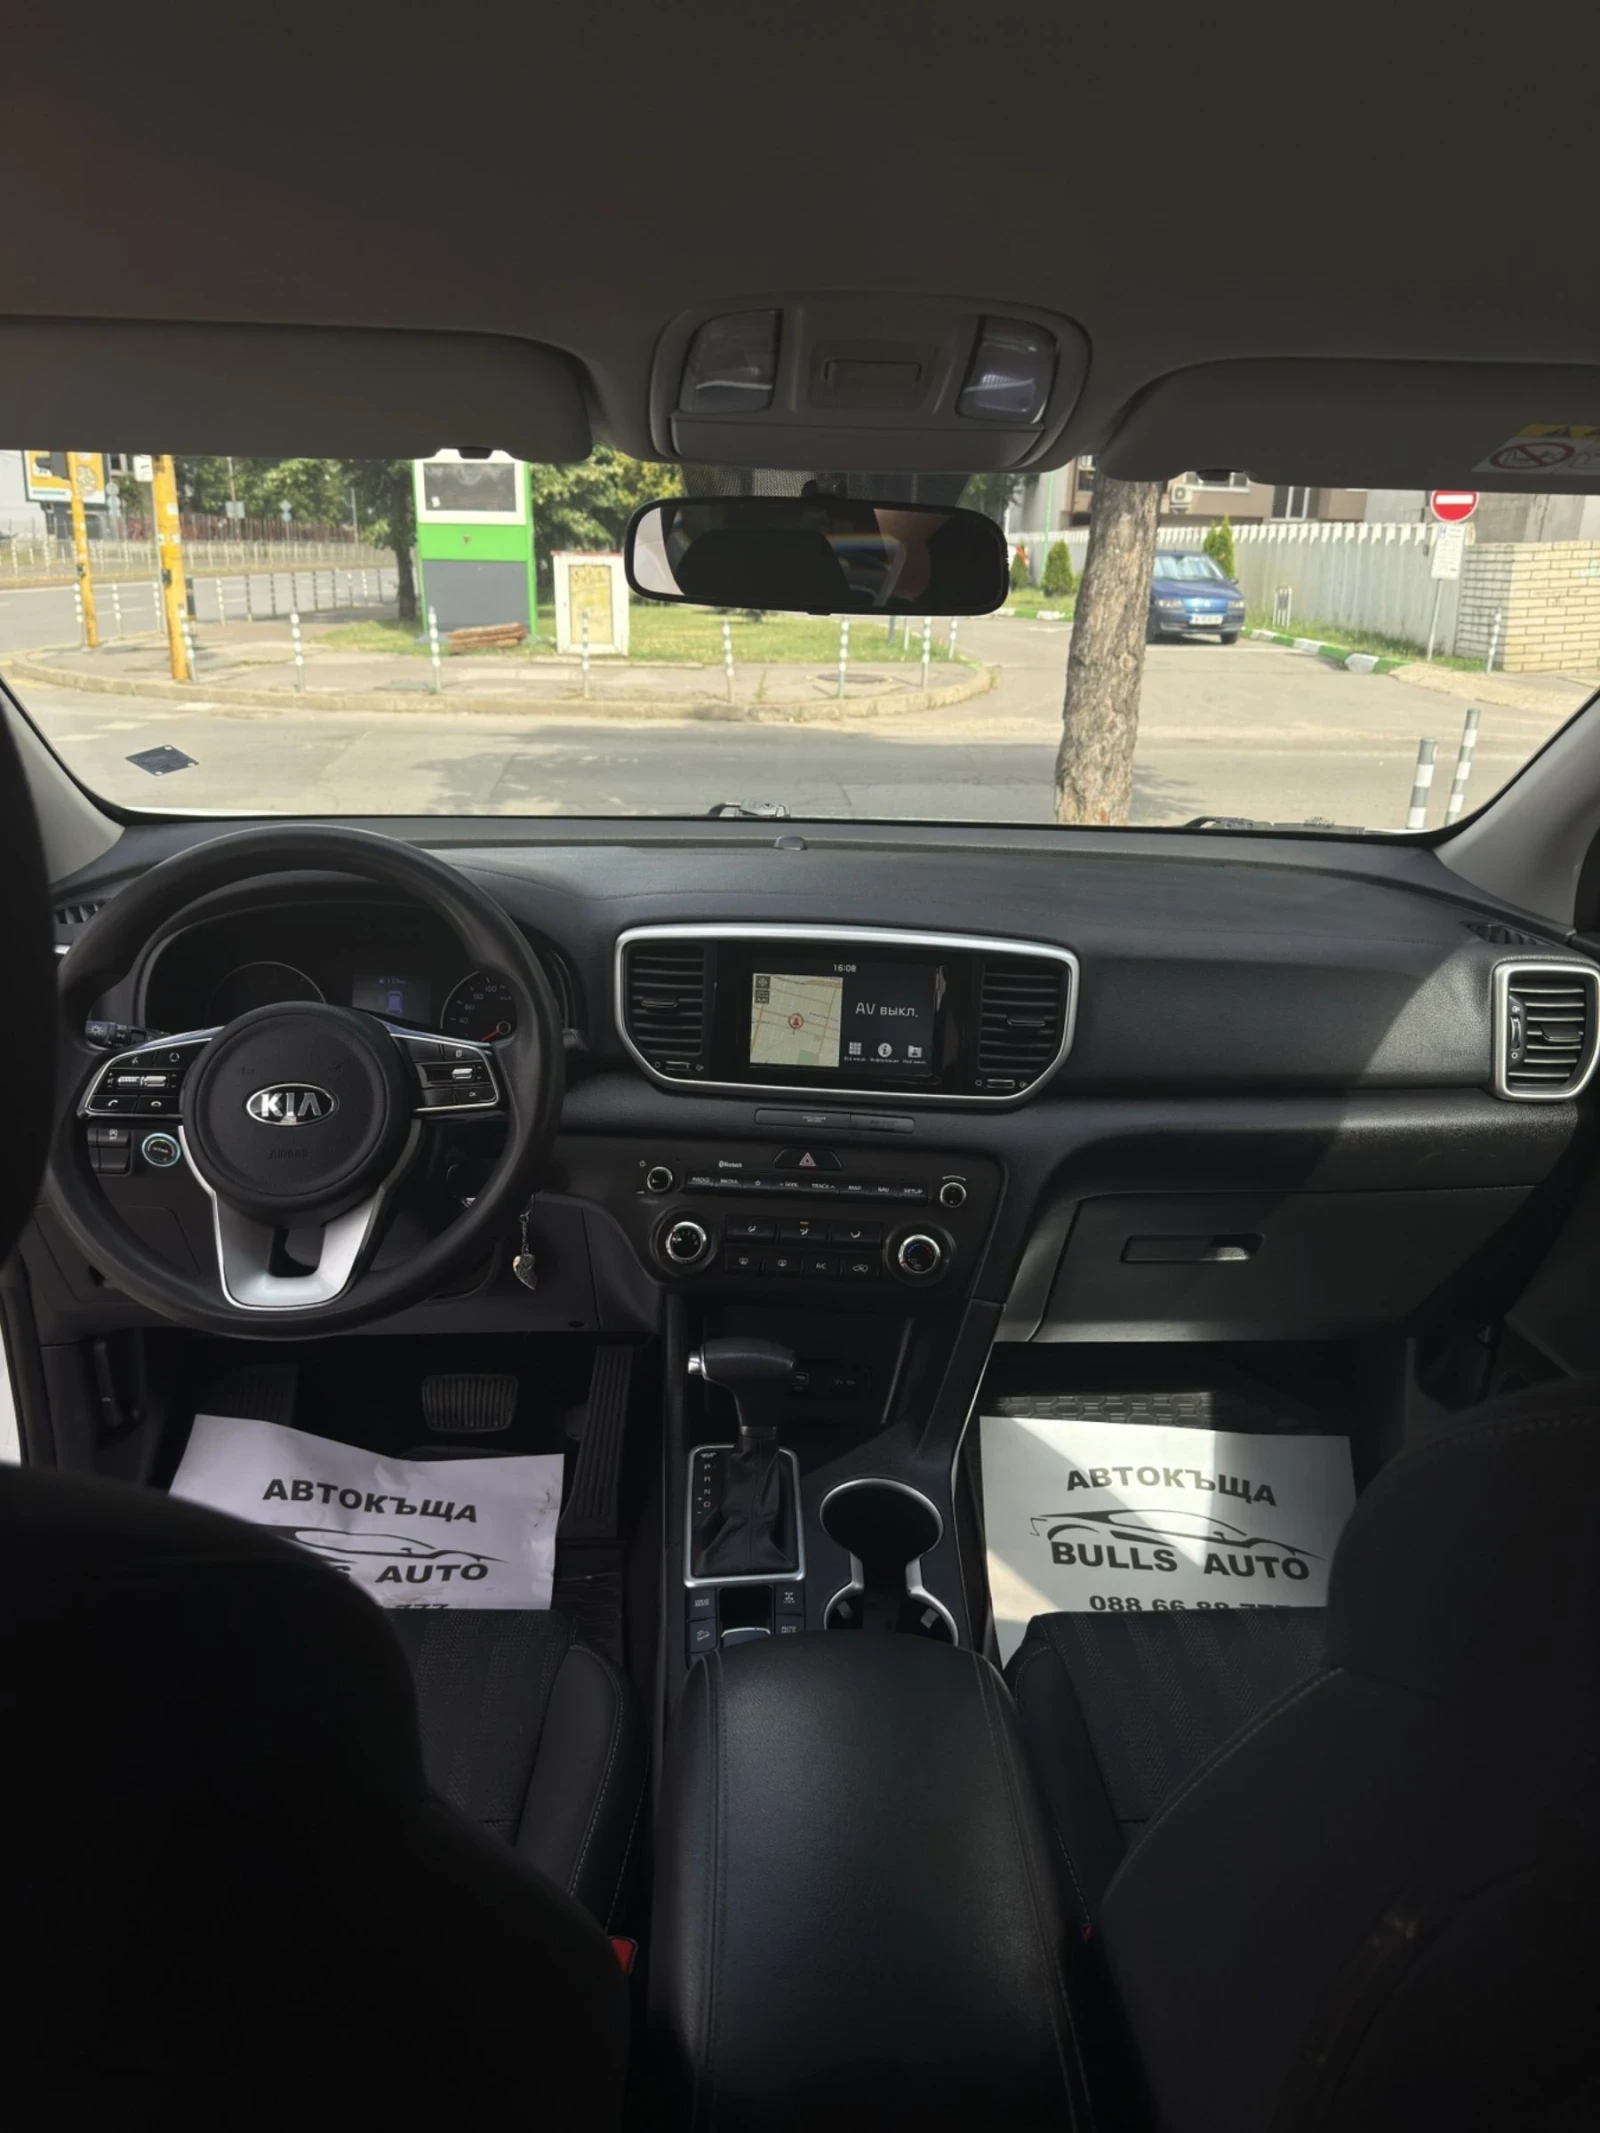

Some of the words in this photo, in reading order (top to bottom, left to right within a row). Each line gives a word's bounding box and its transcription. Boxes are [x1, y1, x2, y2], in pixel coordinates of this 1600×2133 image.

[833, 963, 857, 973] 16:08
[855, 1002, 876, 1015] AV
[880, 1006, 919, 1018] выкл.
[261, 1092, 322, 1117] KIA
[1067, 1466, 1277, 1508] АВТОКЪЩА
[262, 1478, 477, 1523] АВТОКЪЩА
[1051, 1541, 1178, 1572] BULLS
[1203, 1552, 1310, 1581] AUTO
[374, 1563, 489, 1584] AUTO
[1089, 1595, 1142, 1612] 088
